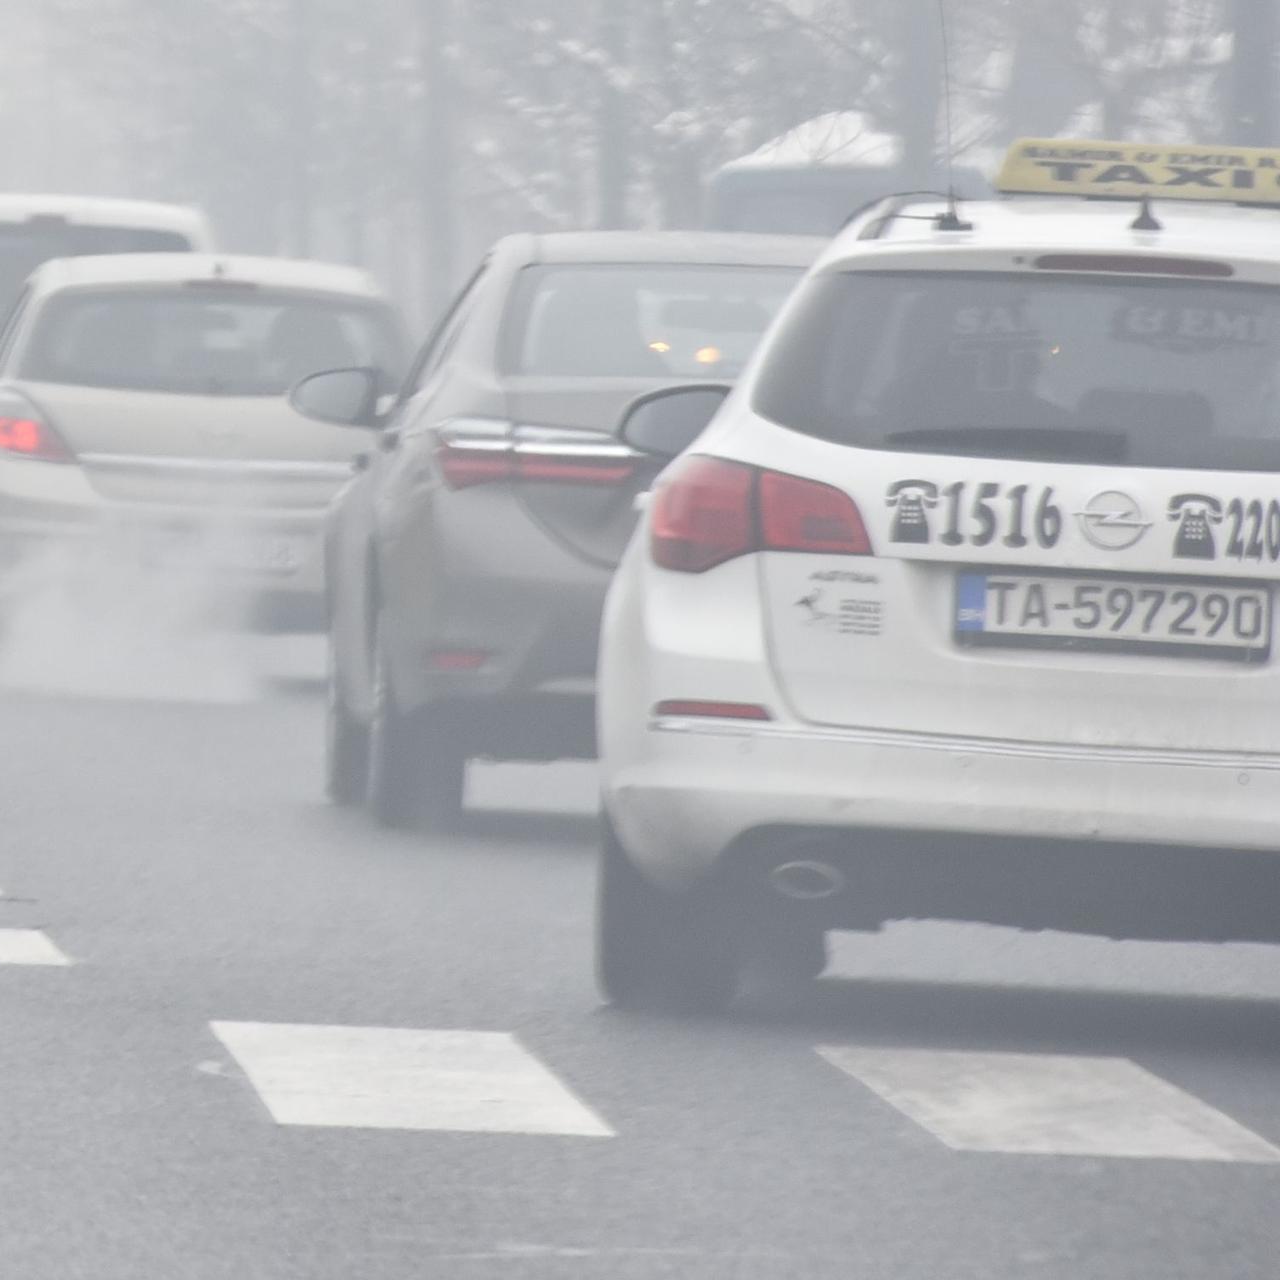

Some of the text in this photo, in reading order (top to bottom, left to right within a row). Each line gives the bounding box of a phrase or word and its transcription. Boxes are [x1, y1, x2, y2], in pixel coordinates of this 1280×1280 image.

[1034, 160, 1255, 189] TAXI
[938, 479, 1064, 549] 1516
[986, 580, 1263, 641] TA-597290
